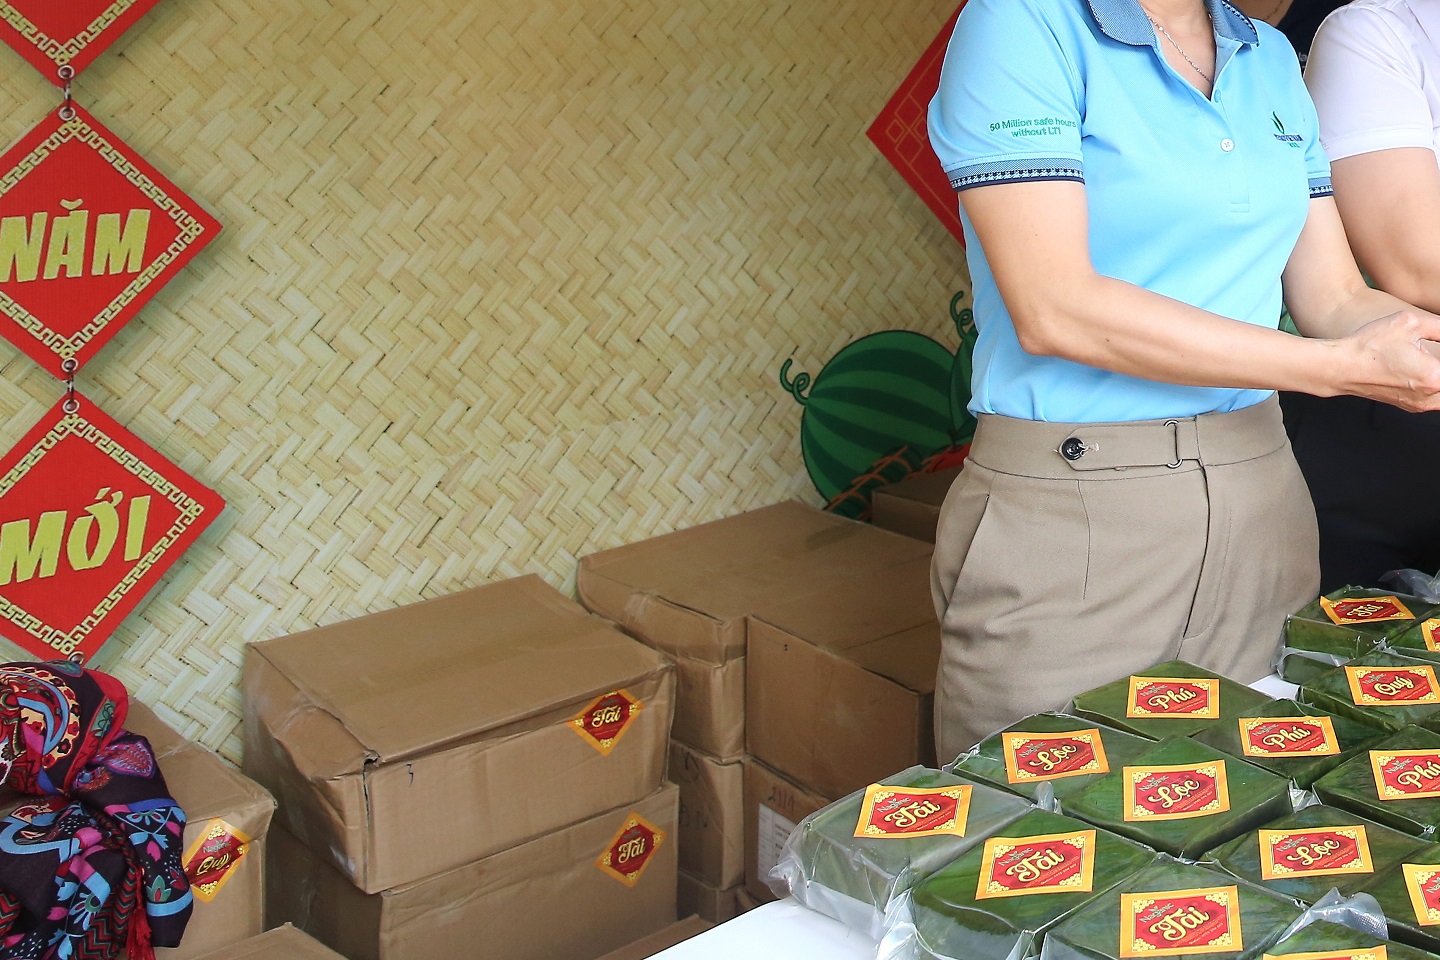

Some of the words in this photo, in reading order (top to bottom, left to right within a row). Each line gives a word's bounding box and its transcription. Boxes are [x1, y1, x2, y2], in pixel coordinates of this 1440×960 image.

[1001, 119, 1032, 129] Million
[1034, 117, 1054, 126] safe
[1011, 126, 1046, 138] without
[0, 197, 151, 283] NĂM
[0, 485, 151, 586] MỚI
[1148, 687, 1197, 711] Phú
[1373, 674, 1414, 697] Quý
[1262, 724, 1311, 750] Phú
[1030, 742, 1078, 773] Lộc
[1148, 777, 1201, 809] Lộc
[1287, 837, 1341, 867] Lộc
